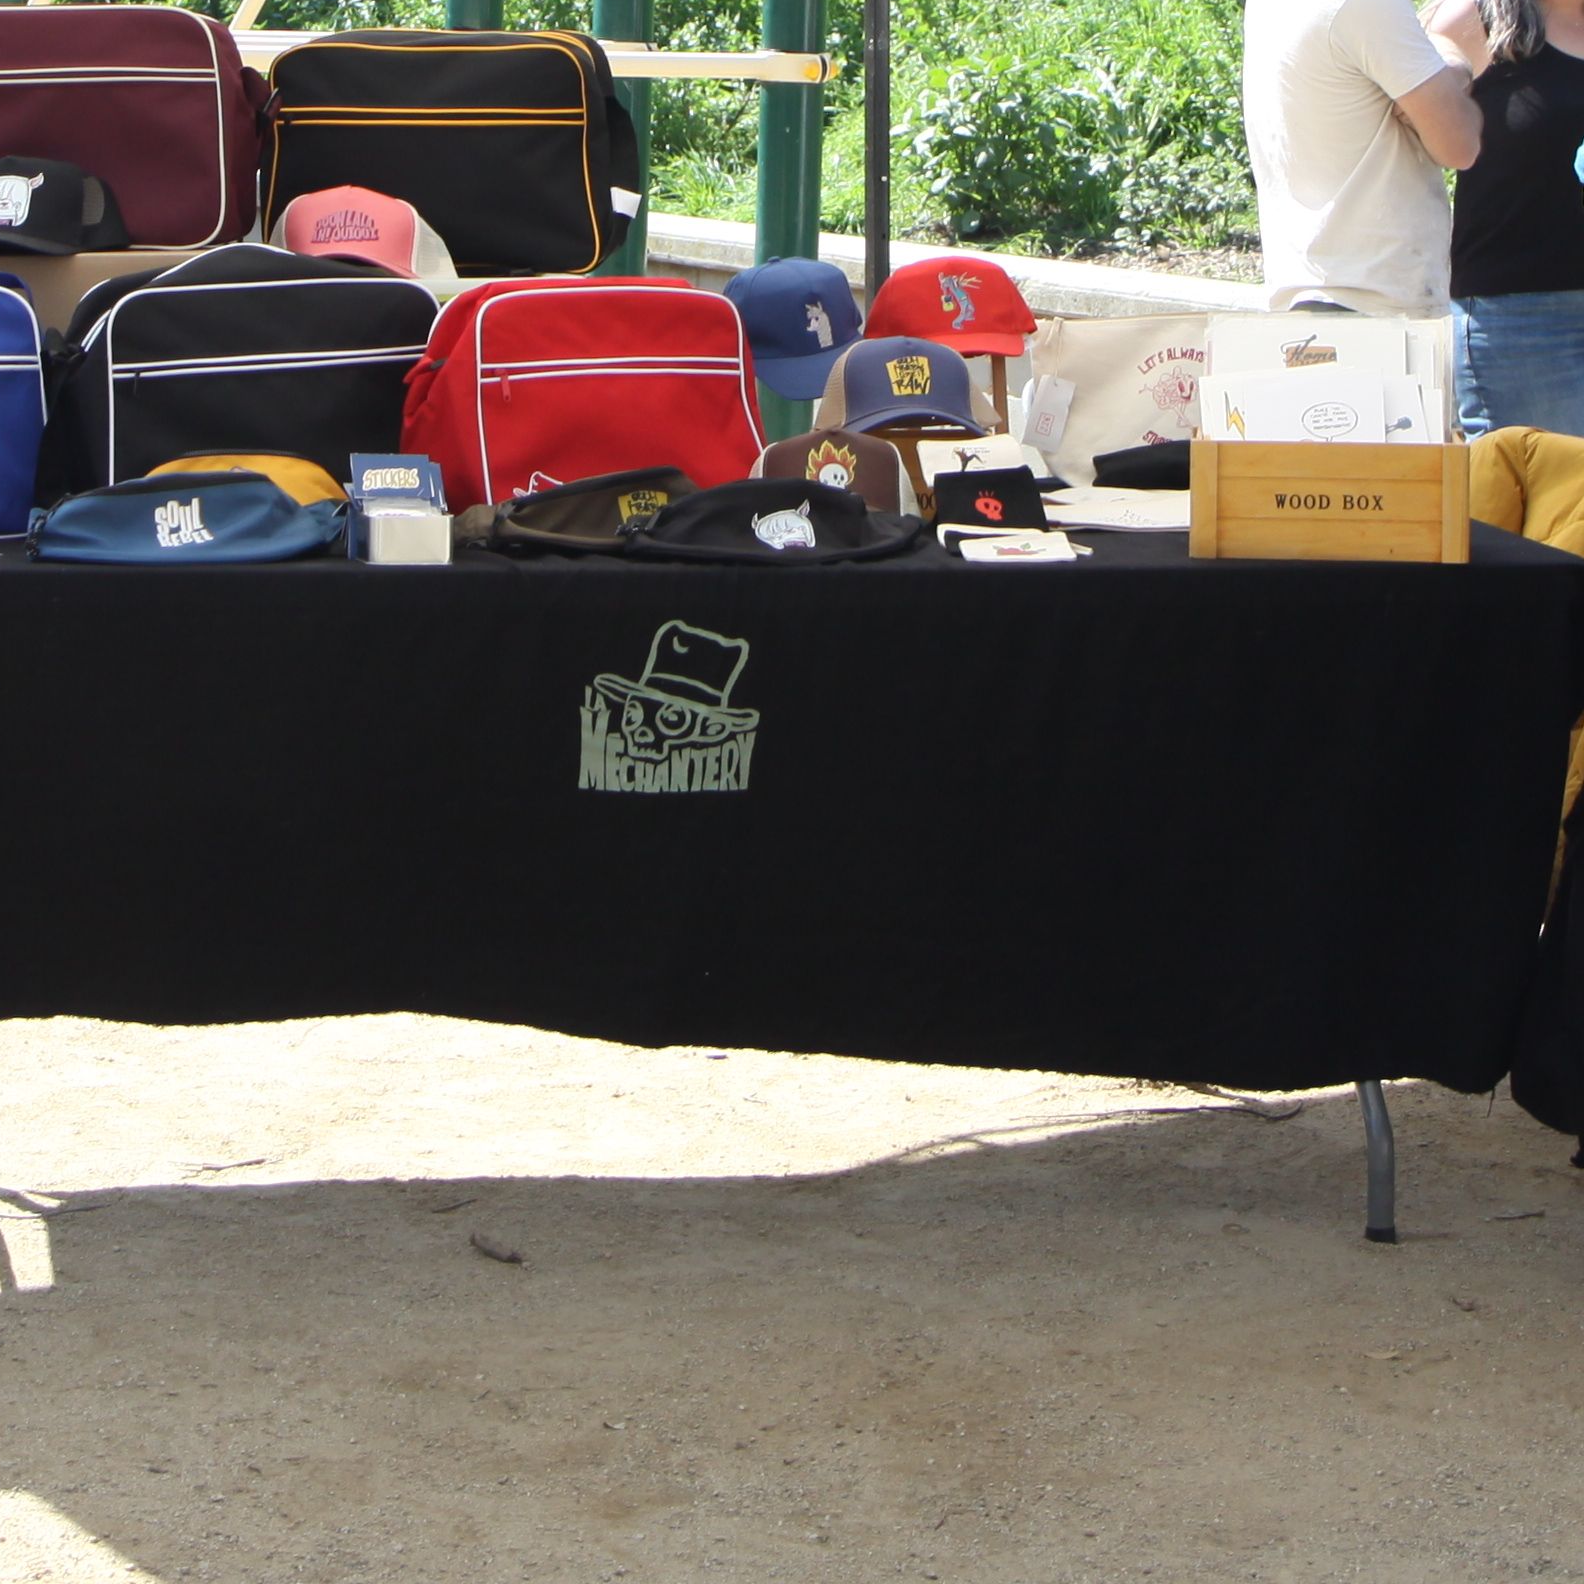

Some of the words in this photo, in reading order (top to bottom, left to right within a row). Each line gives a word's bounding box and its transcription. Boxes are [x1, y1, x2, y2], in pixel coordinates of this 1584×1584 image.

[1137, 349, 1165, 375] LET'S
[363, 468, 419, 491] STICKERS
[1275, 493, 1331, 511] WOOD
[1342, 494, 1384, 511] BOX
[155, 497, 204, 534] SOUL
[584, 685, 608, 712] LA
[578, 705, 757, 793] MECHANTERY
